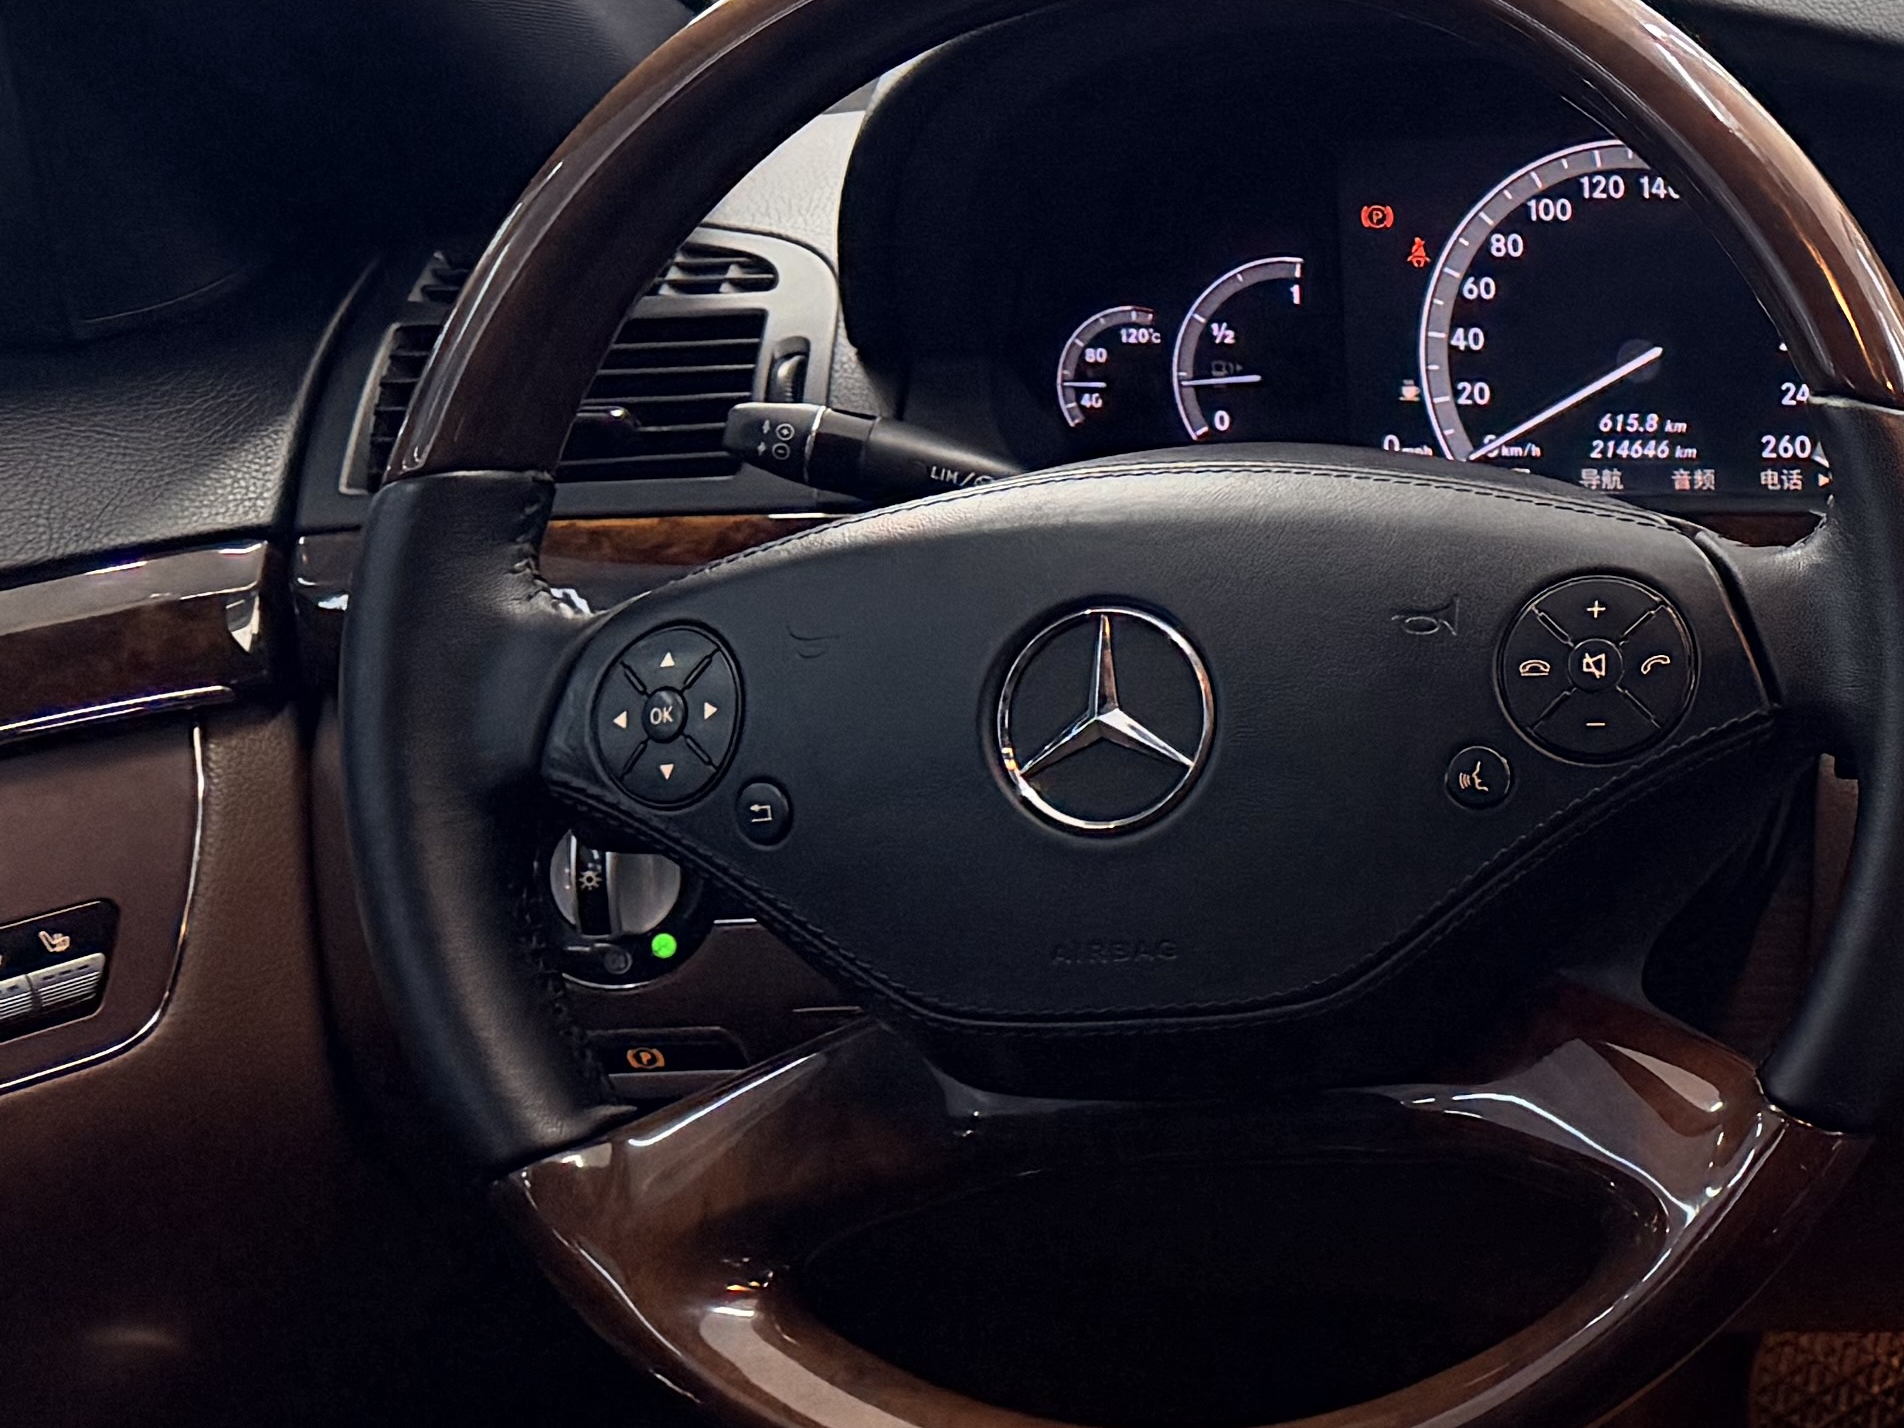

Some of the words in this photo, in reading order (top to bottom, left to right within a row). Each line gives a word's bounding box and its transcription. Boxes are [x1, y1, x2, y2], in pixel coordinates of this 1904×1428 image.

[1580, 175, 1625, 199] 120
[1527, 198, 1573, 222] 100
[1489, 233, 1524, 258] 80
[1290, 283, 1301, 305] 1
[1462, 276, 1496, 300] 60
[1449, 327, 1485, 351] 40
[1084, 347, 1108, 363] 80
[1080, 393, 1103, 409] 40
[1457, 382, 1491, 406] 20
[1214, 410, 1231, 432] 0
[1598, 412, 1660, 433] 615.8
[1664, 419, 1688, 433] km
[1501, 441, 1542, 458] km/h
[1589, 439, 1671, 459] 214646
[1675, 445, 1698, 458] km
[1760, 435, 1812, 459] 260
[1579, 468, 1625, 491] 导航
[1671, 468, 1717, 491] 音频
[1760, 468, 1804, 491] 电话
[650, 705, 674, 725] OK
